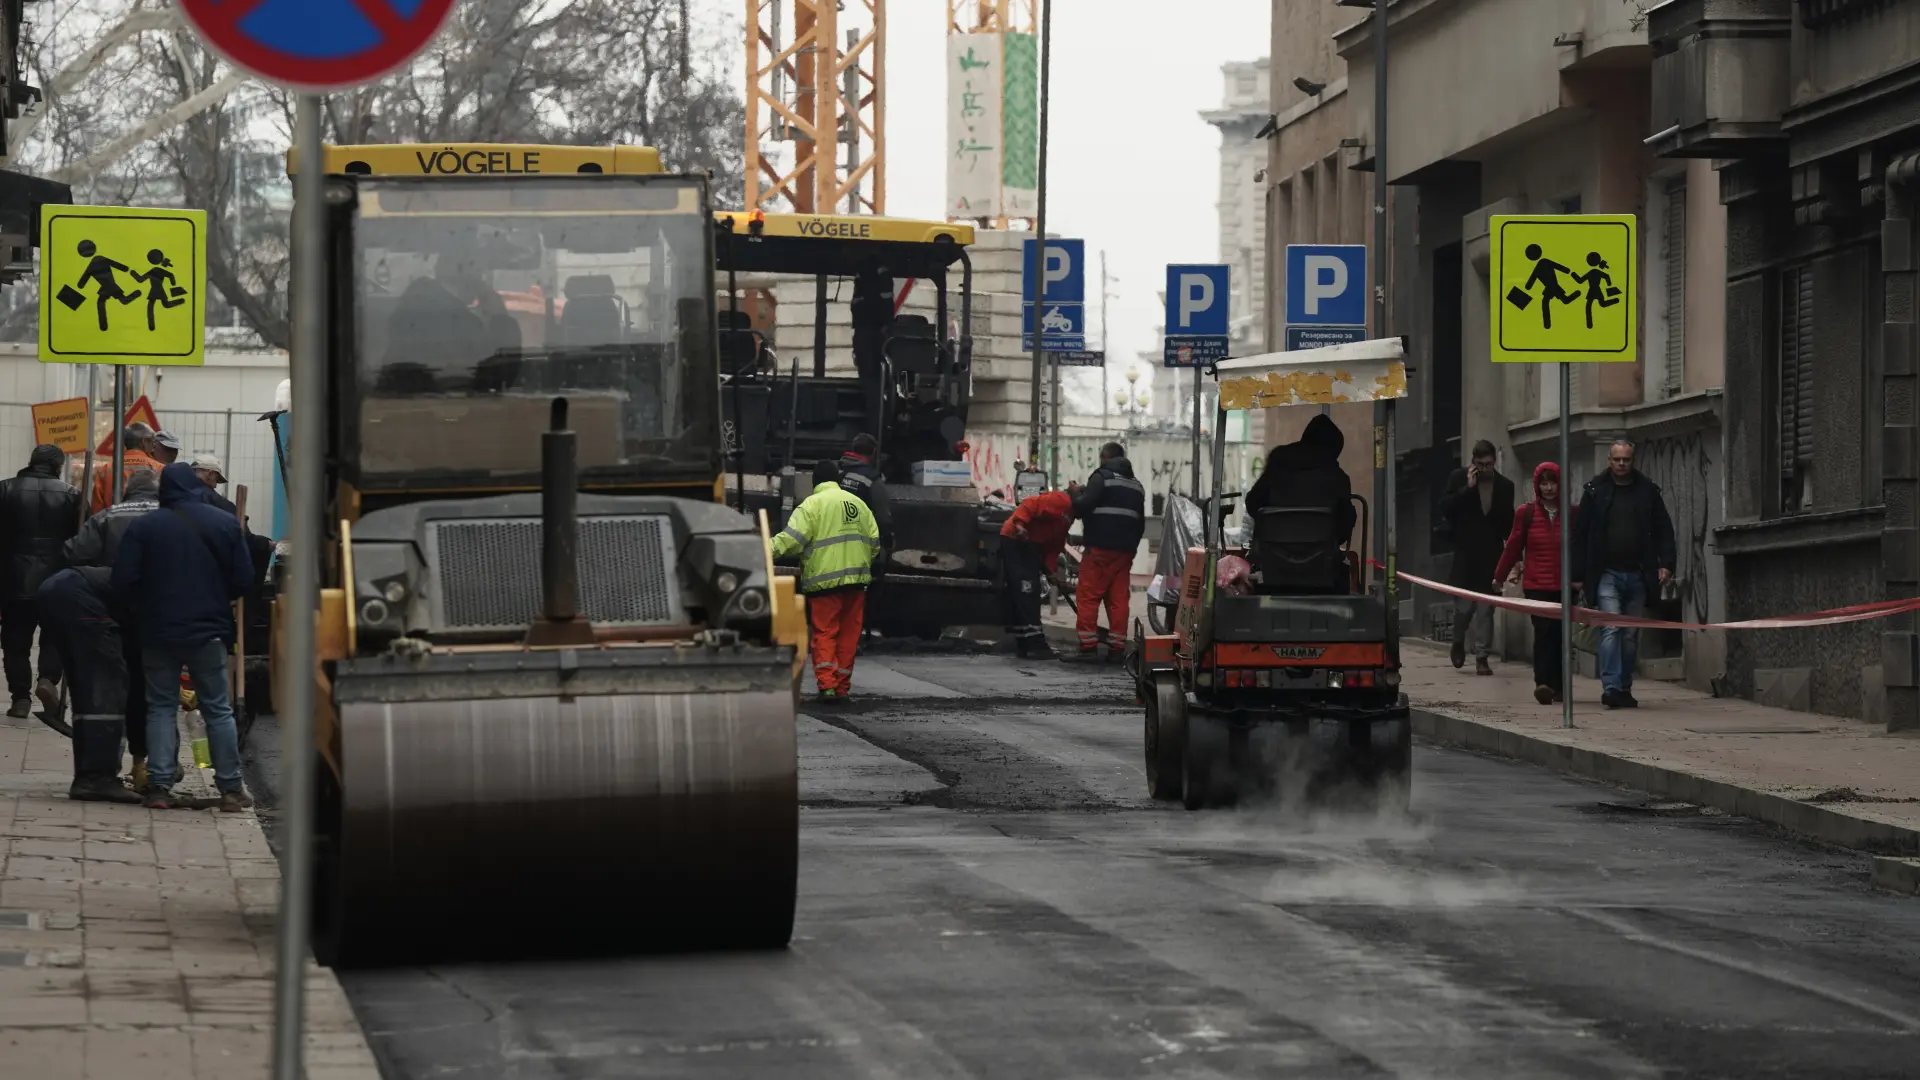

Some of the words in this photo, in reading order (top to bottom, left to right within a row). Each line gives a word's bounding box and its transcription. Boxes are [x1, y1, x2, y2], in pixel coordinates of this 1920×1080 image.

[416, 147, 540, 174] VÖGELE
[797, 218, 870, 237] VÖGELE
[1042, 246, 1070, 295] P
[1304, 255, 1349, 315] P
[1179, 273, 1215, 327] P
[1280, 648, 1318, 657] HAMM
